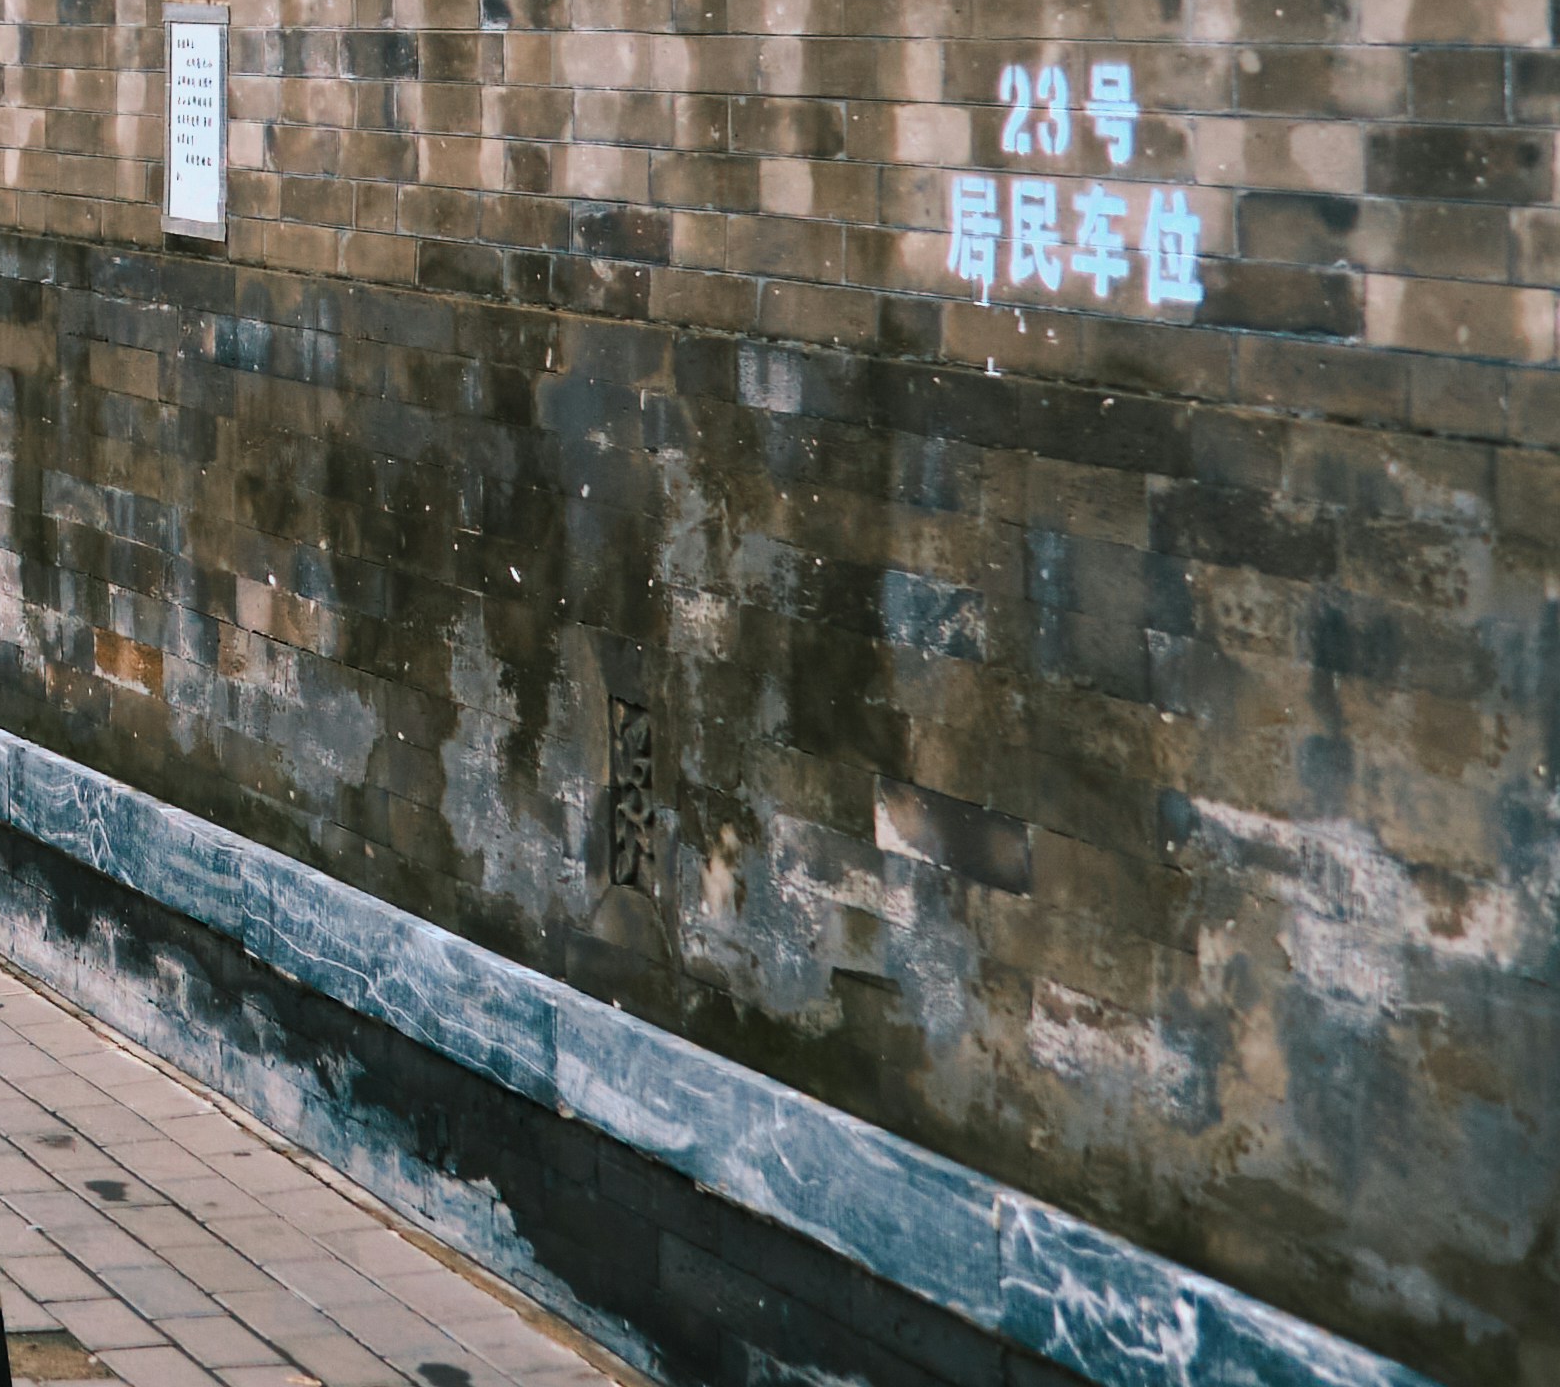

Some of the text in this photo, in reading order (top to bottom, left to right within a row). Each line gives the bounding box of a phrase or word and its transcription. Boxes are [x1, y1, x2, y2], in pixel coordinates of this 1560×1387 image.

[998, 60, 1140, 166] 23号
[946, 175, 1205, 306] 居民车位
